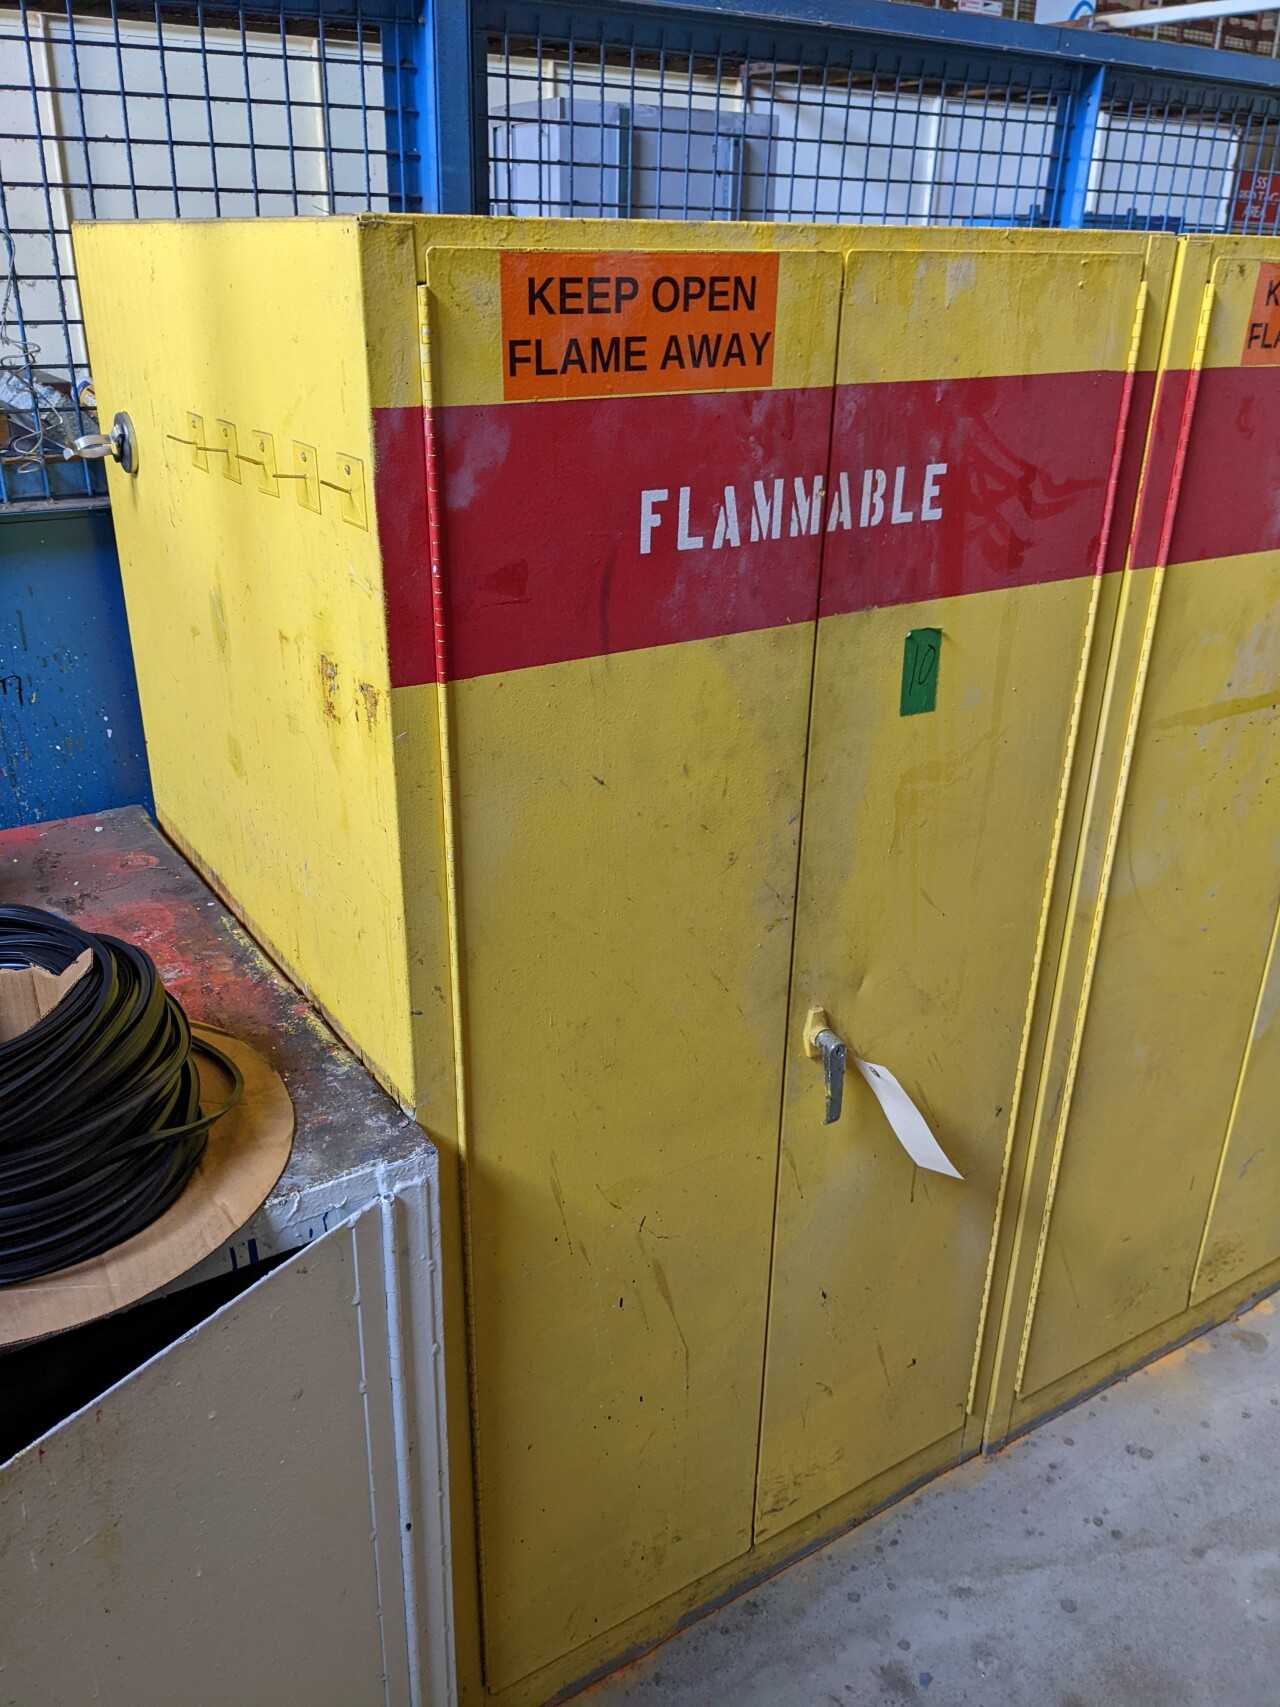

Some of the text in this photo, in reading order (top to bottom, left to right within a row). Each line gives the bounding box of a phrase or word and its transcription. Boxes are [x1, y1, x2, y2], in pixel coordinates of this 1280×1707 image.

[528, 275, 757, 315] KEEP OPEN
[508, 331, 772, 377] FLAME AWAY
[639, 463, 947, 554] FLAMMABLE
[908, 643, 937, 697] 10
